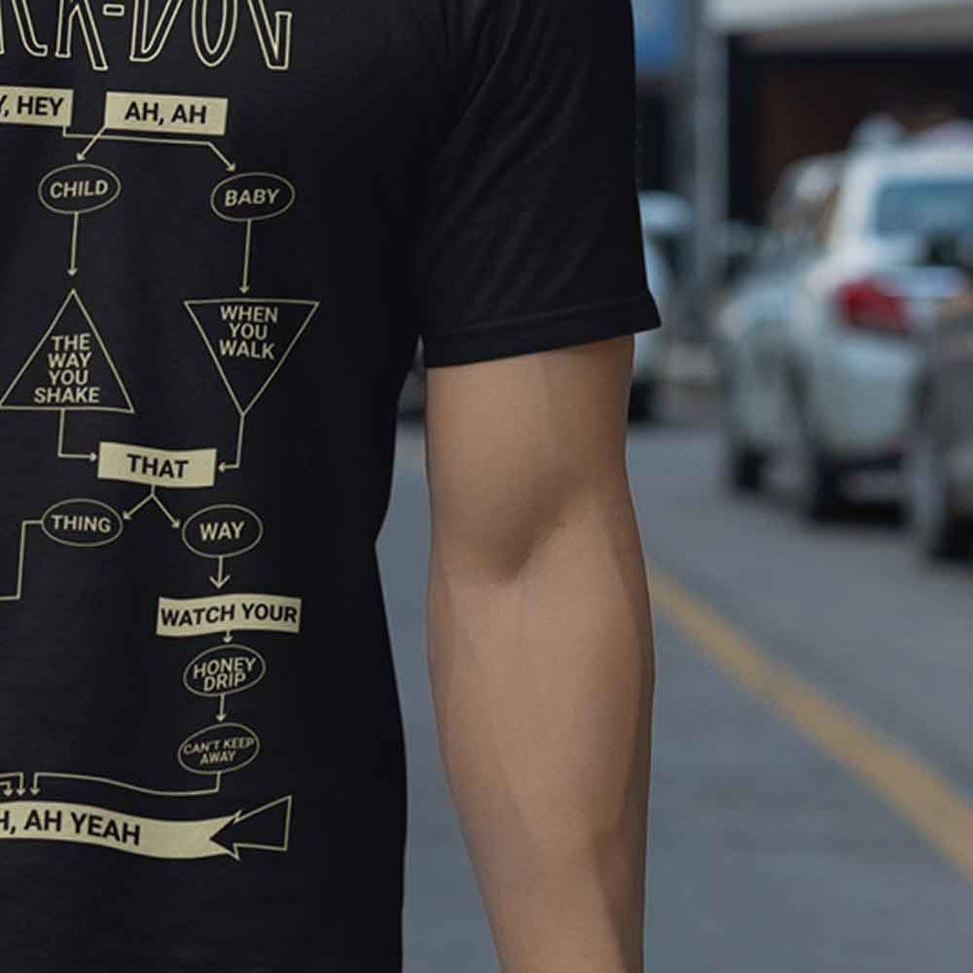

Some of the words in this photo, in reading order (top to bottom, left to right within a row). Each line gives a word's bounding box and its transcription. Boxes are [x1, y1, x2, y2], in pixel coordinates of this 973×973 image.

[16, 96, 64, 117] HEY
[124, 102, 166, 125] AH,
[171, 104, 206, 125] AH
[49, 178, 108, 199] CHILD
[224, 187, 281, 207] BABY
[220, 305, 278, 324] WHEN
[229, 322, 268, 341] YOU
[52, 333, 91, 352] THE
[219, 340, 275, 360] WALK
[48, 351, 91, 370] WAY
[49, 368, 89, 387] YOU
[34, 385, 100, 405] SHAKE
[127, 454, 189, 478] THAT
[51, 514, 111, 534] THING
[199, 521, 245, 542] WAY
[161, 604, 235, 625] WATCH
[242, 603, 298, 623] YOUR
[193, 657, 257, 679] HONEY
[203, 672, 246, 691] DRIP
[224, 737, 255, 750] KEEP
[200, 751, 236, 764] AWAY
[24, 810, 62, 831] AH
[71, 815, 140, 845] YEAH
